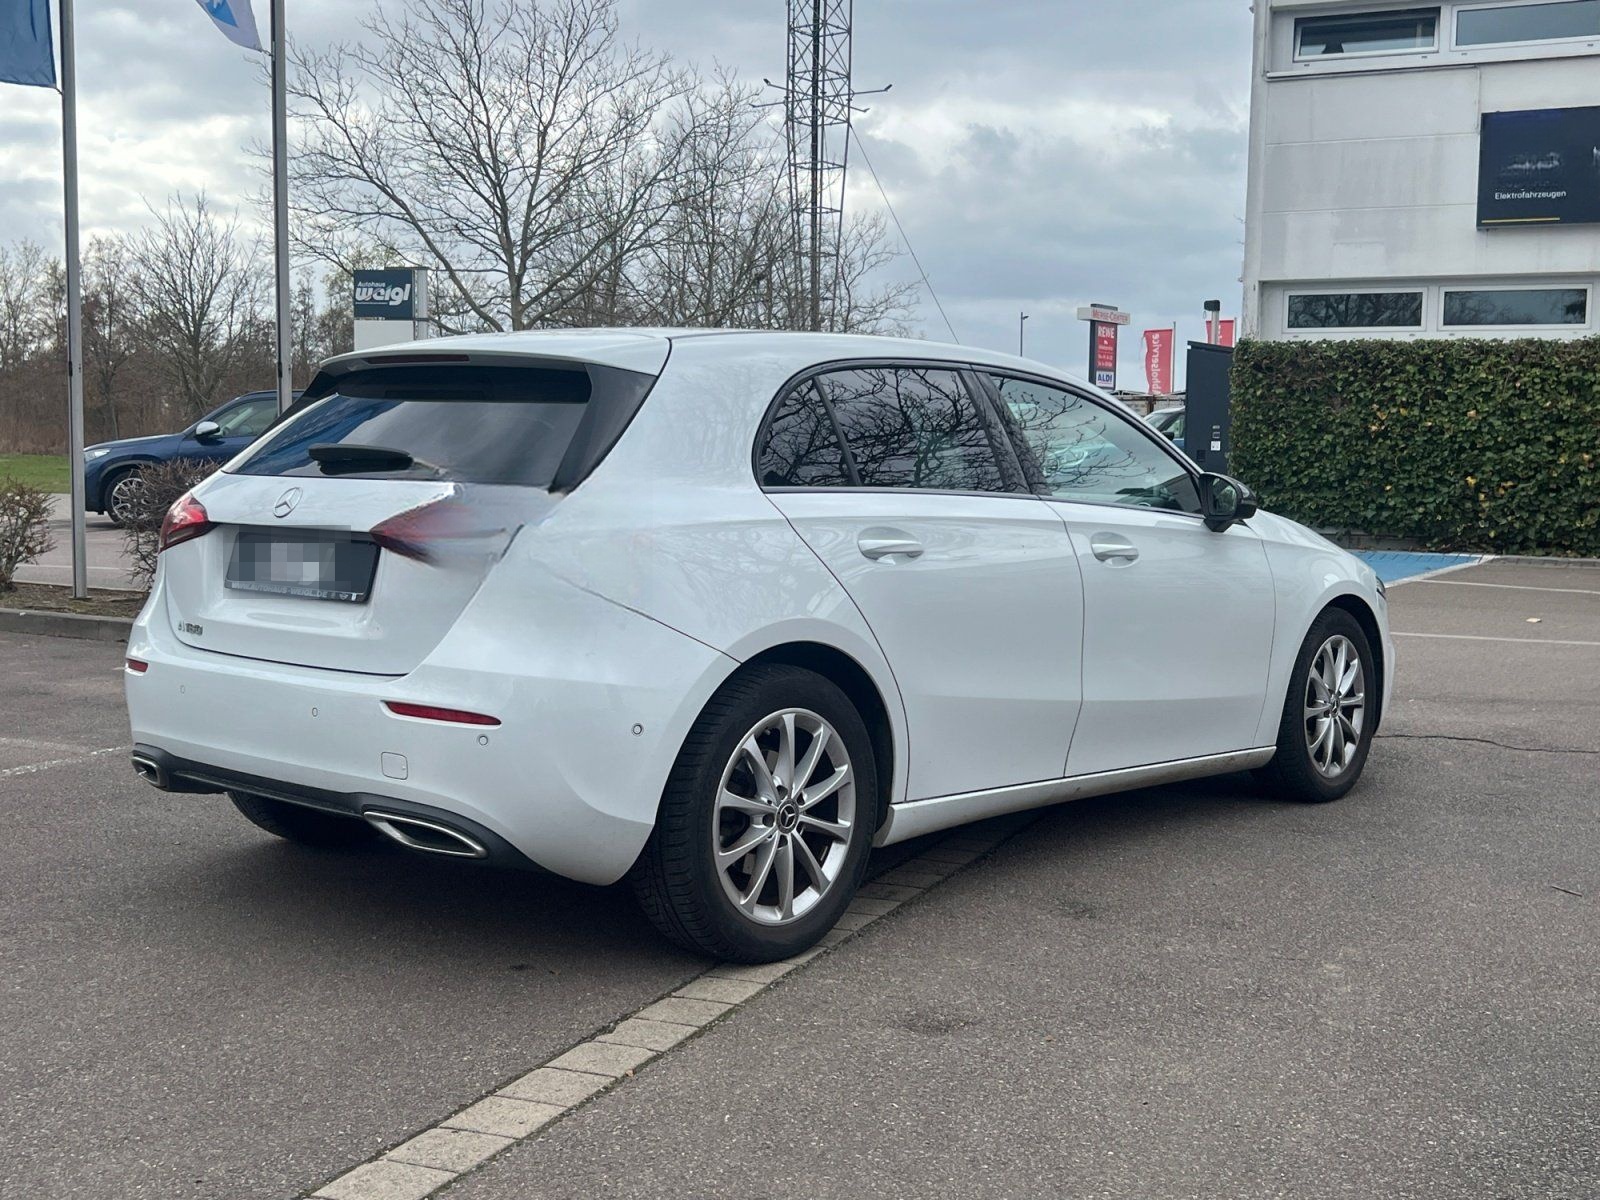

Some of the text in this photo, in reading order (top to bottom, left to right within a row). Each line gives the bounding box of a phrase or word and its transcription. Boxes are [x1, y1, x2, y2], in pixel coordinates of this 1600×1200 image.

[1494, 190, 1567, 200] Elektrofahrzeugen
[1097, 326, 1115, 339] REWE
[1097, 373, 1113, 383] ALDI
